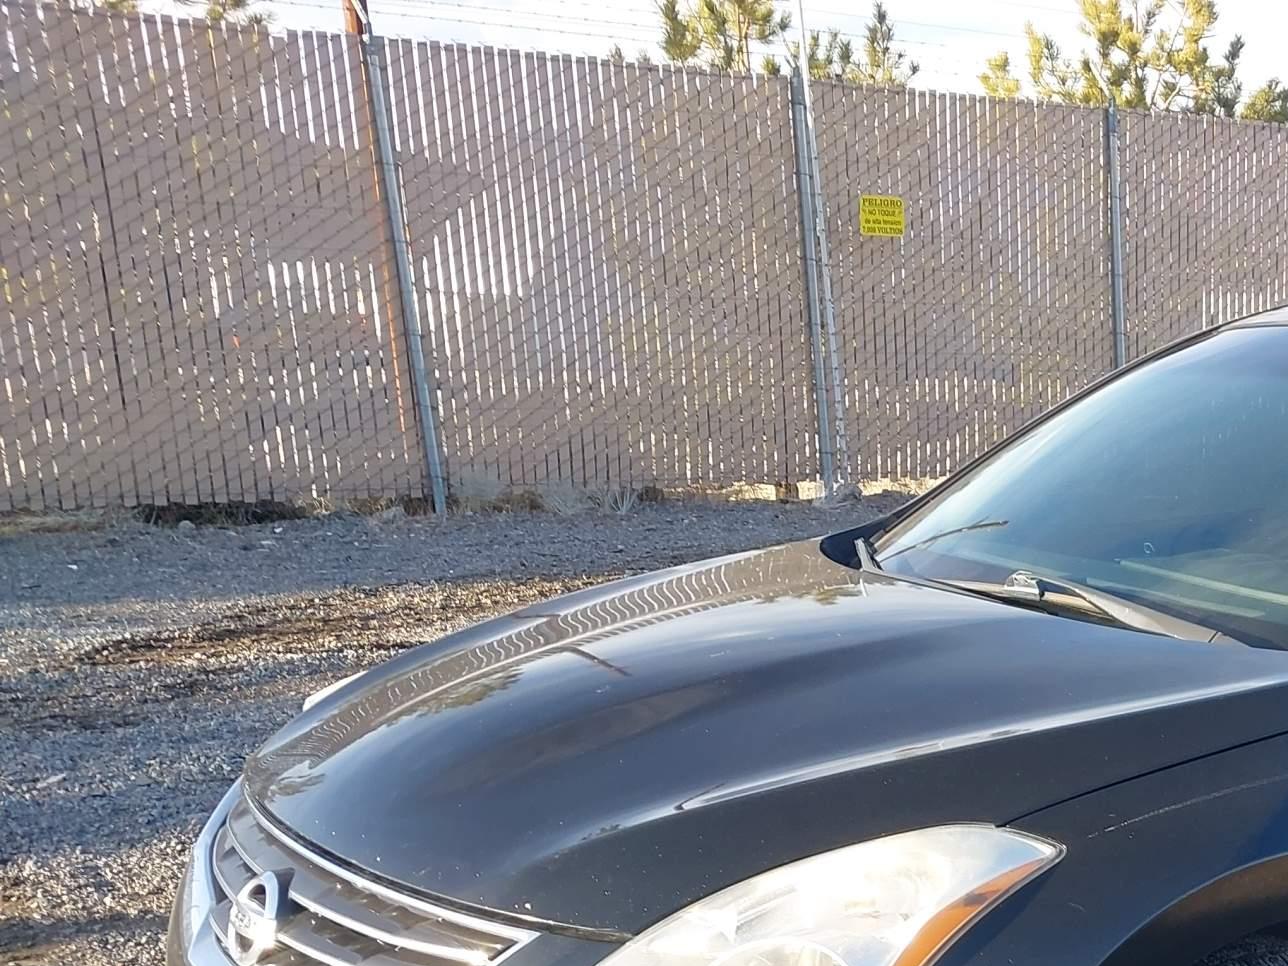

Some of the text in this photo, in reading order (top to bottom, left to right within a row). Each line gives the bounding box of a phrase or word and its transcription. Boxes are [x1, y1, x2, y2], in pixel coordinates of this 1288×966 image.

[862, 197, 903, 208] PELIGRO
[867, 208, 897, 217] NO TOQUE
[876, 226, 904, 235] VOLTIOS
